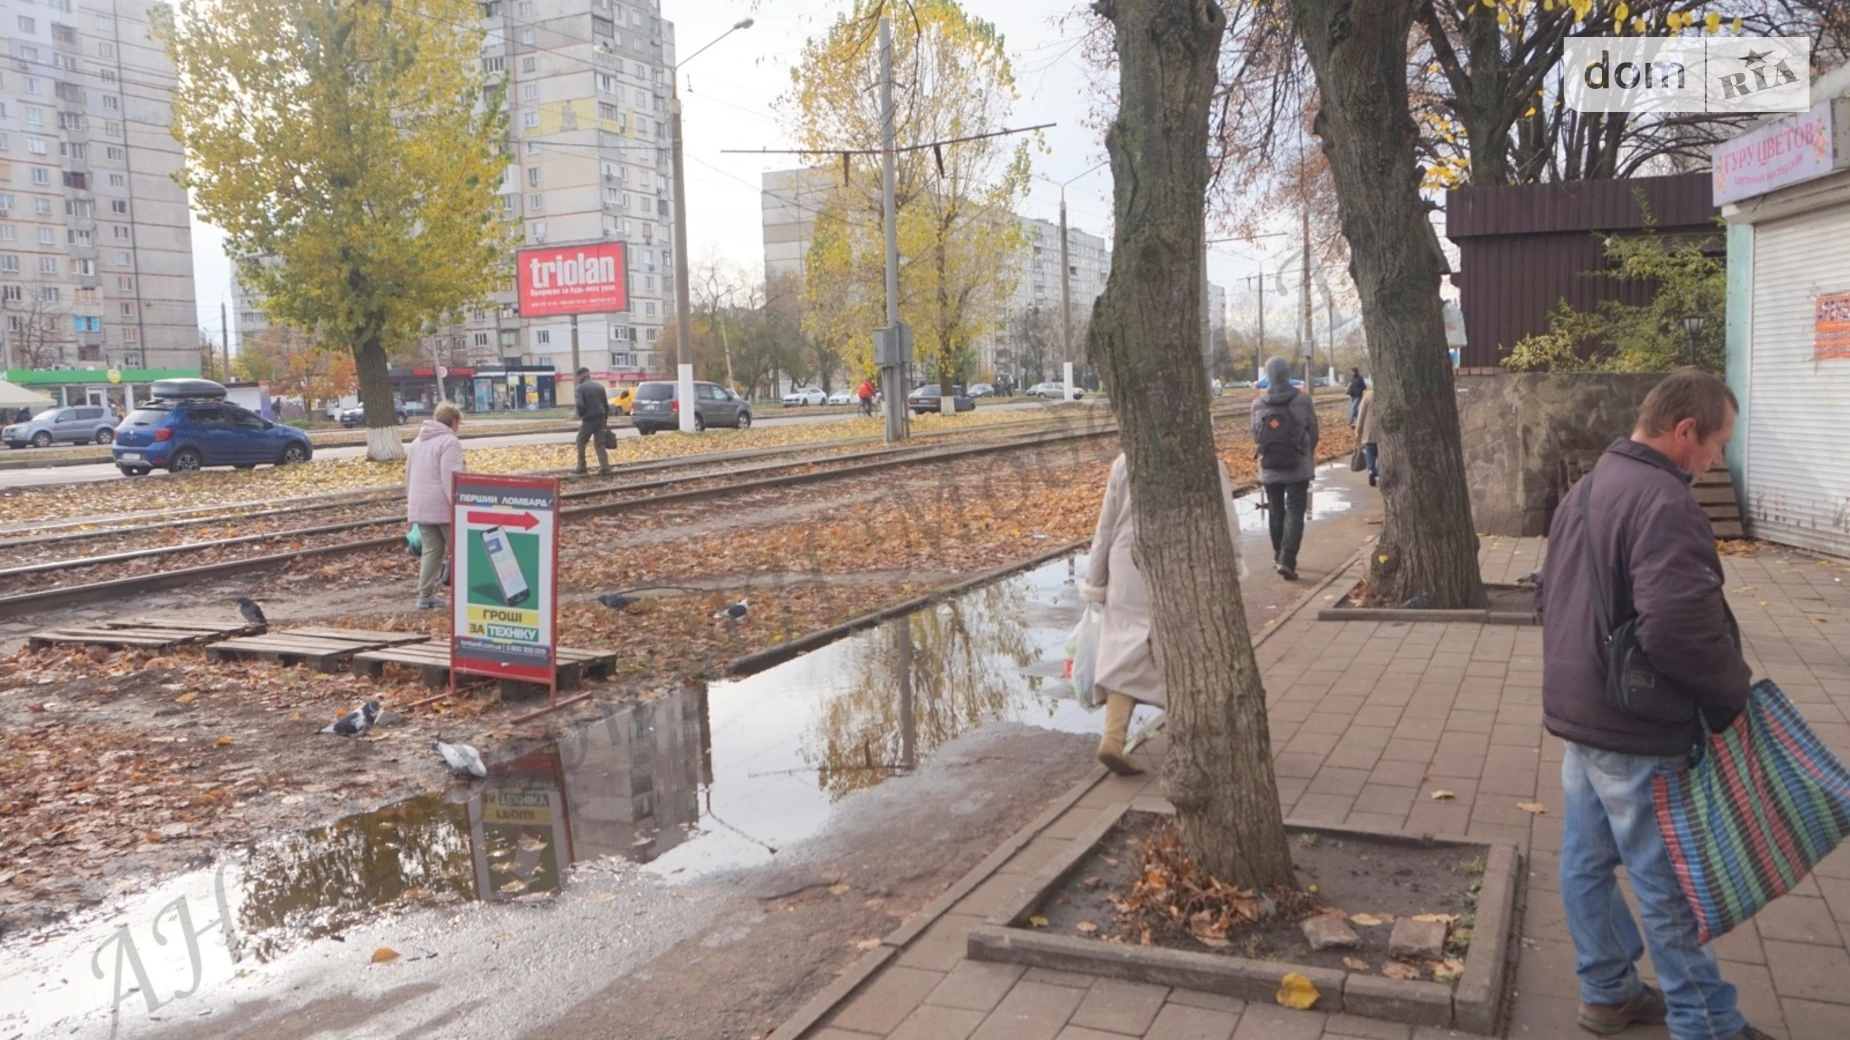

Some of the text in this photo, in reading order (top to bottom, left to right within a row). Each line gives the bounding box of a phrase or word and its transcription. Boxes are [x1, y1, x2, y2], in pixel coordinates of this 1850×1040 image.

[1722, 121, 1815, 174] ГУРУ ЦВЕТОВ
[530, 253, 614, 288] triolan
[501, 496, 548, 507] ЛОМБАРД
[483, 610, 522, 623] ГРОШІ
[469, 623, 537, 640] ЗА ТЕХНІКУ
